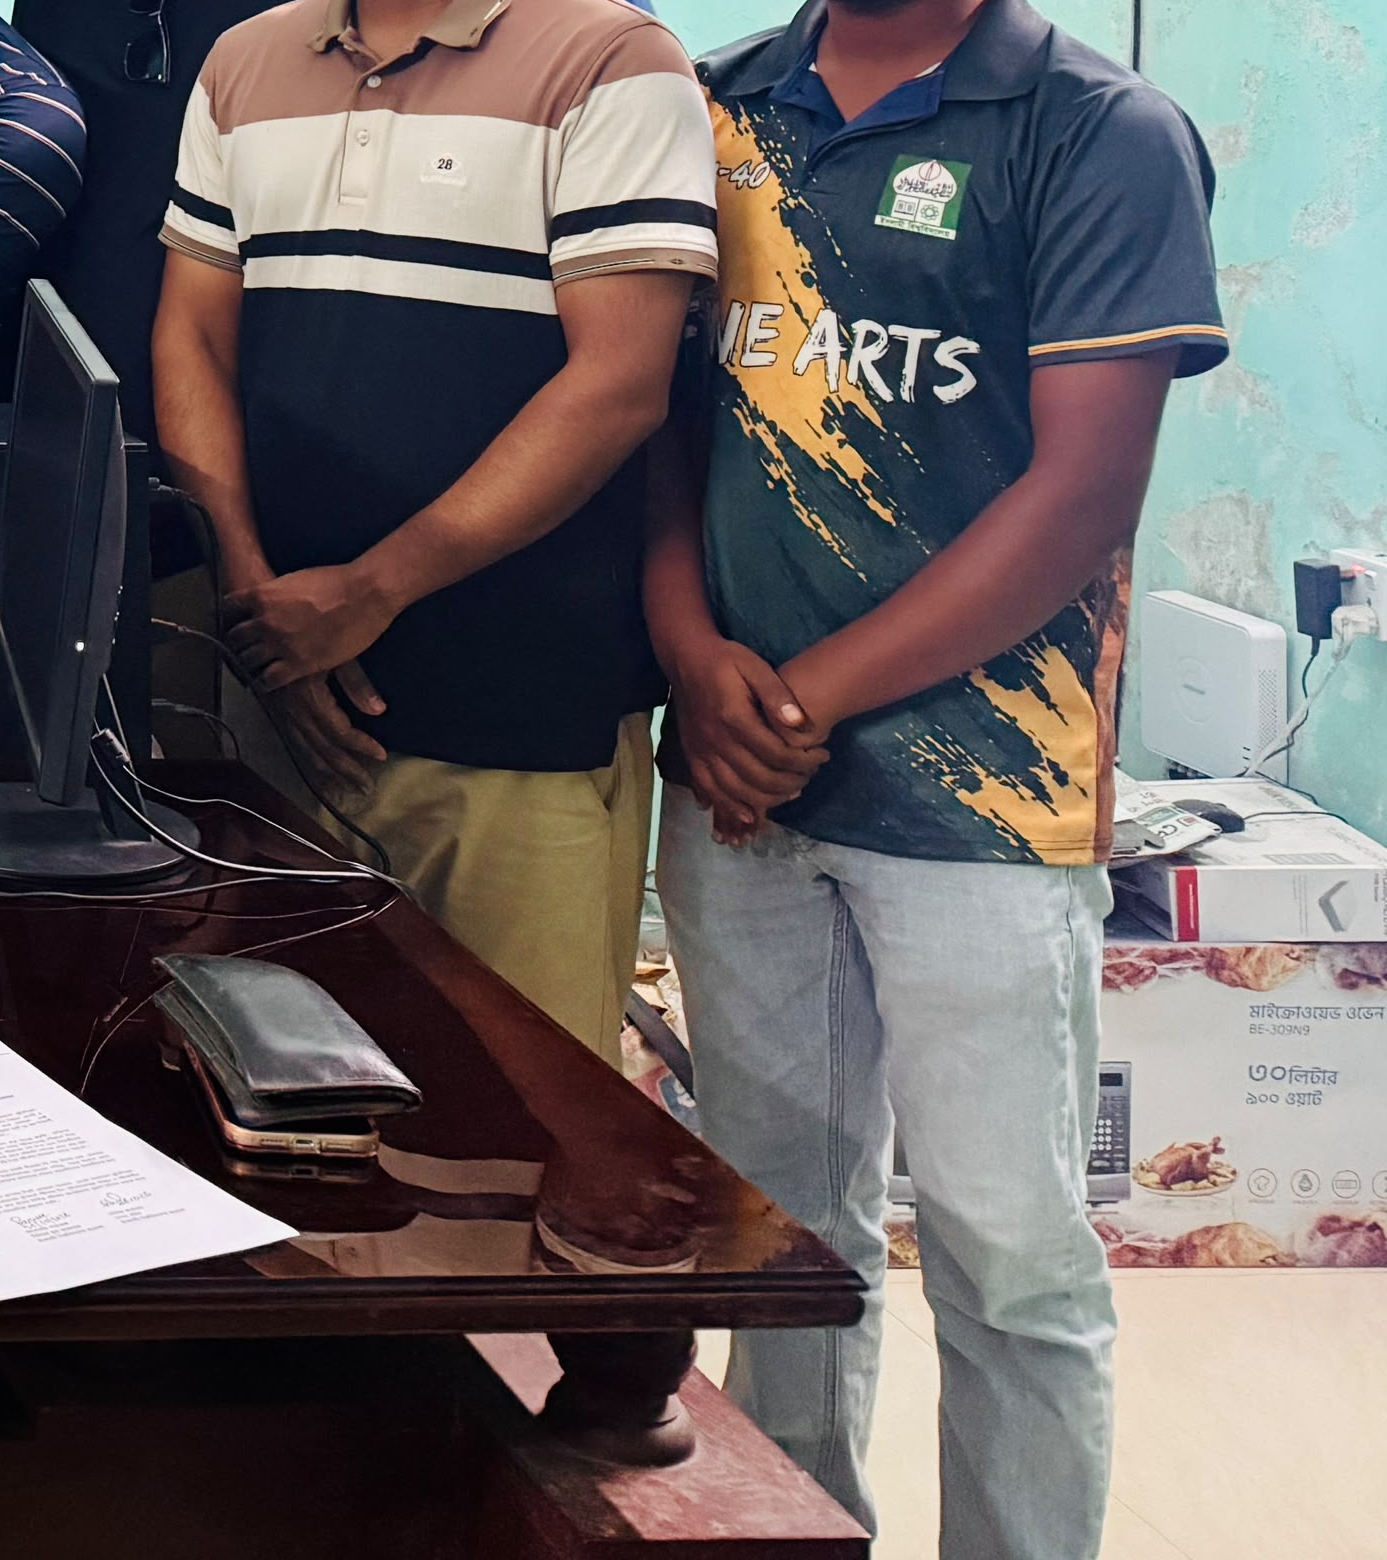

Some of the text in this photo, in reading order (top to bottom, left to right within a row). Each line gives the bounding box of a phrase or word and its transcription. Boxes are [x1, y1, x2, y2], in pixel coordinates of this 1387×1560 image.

[437, 158, 454, 170] 28
[716, 159, 771, 190] -40
[793, 307, 981, 405] ARTS
[1347, 1007, 1385, 1020] ওভেন
[1249, 1024, 1310, 1035] BE-309N9
[1246, 1090, 1323, 1107] ৯০০ ওয়াট
